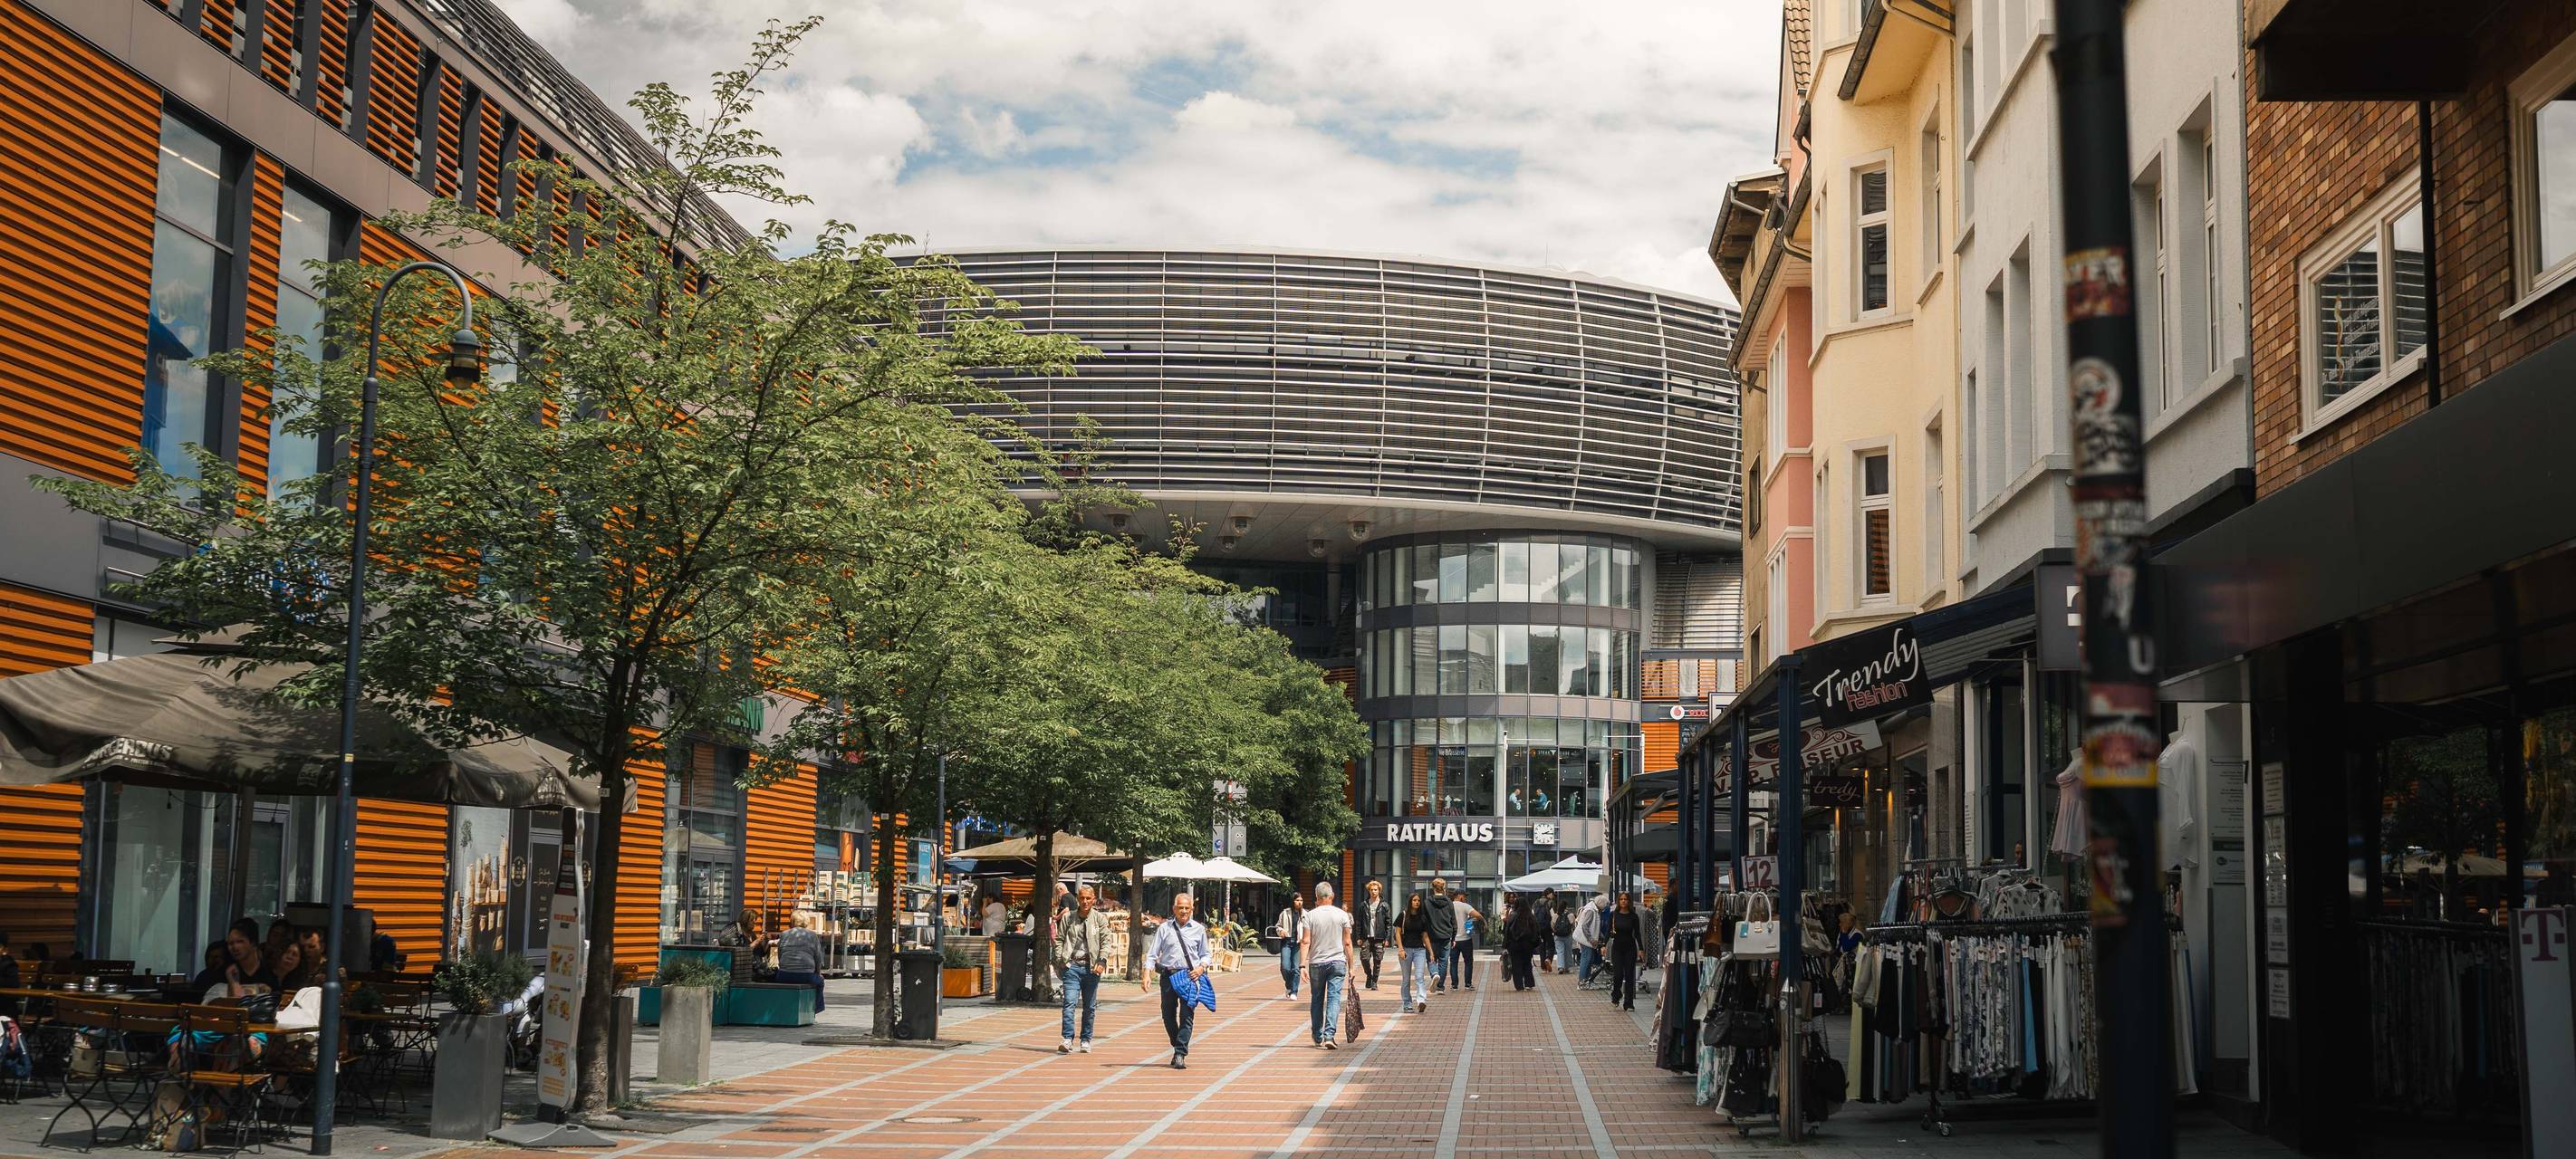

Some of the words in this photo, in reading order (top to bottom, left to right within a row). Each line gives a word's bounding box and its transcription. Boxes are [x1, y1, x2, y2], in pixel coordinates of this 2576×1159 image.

[1812, 627, 1919, 707] Trendy
[1770, 738, 1865, 778] FISEUR
[1812, 780, 1860, 802] tredy
[1387, 822, 1494, 843] RATHAUS
[1748, 860, 1773, 888] 12
